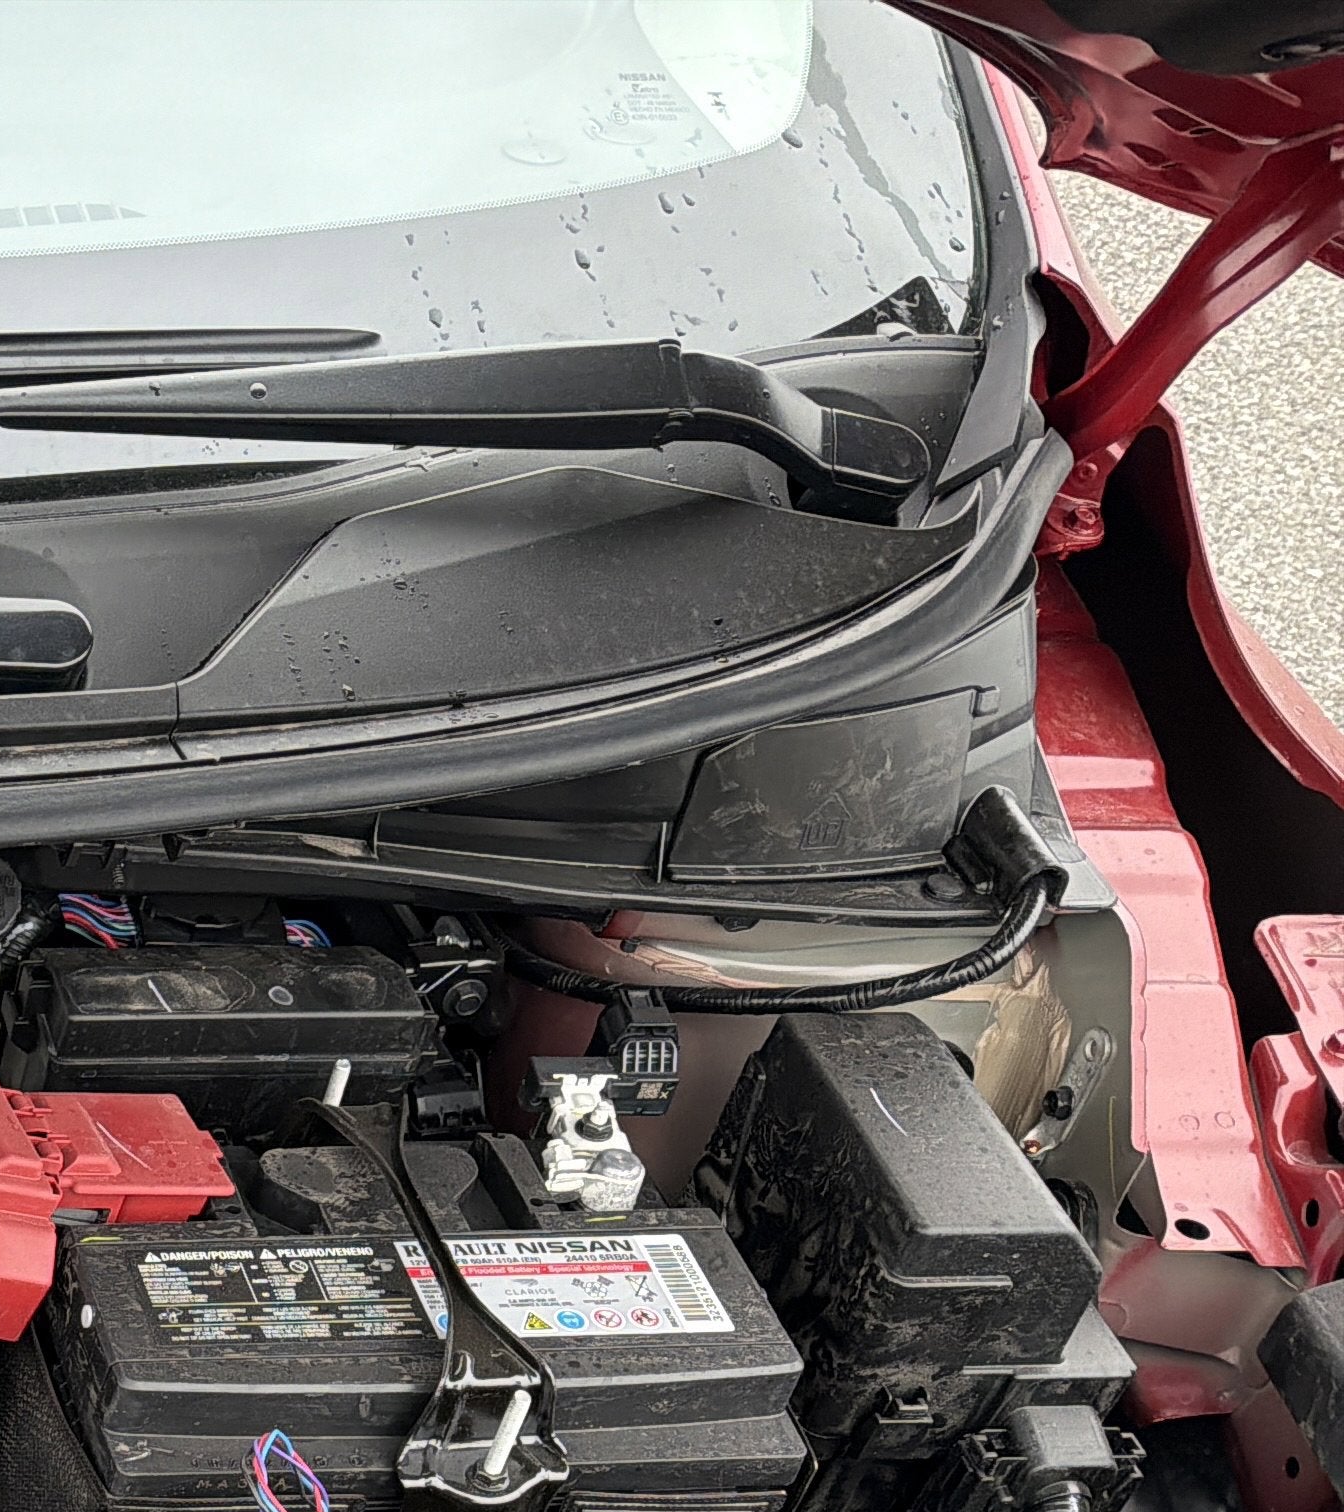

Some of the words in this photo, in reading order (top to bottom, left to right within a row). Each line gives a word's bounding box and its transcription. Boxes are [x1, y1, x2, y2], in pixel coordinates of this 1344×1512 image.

[619, 73, 666, 81] NISSAN
[277, 1247, 374, 1259] PELIGRO/VENENO
[404, 1242, 507, 1258] RAULT
[515, 1240, 633, 1255] NISSAN
[161, 1250, 254, 1261] DANGER/POISON
[505, 1266, 540, 1275] Battery
[505, 1288, 554, 1296] CLARIOS
